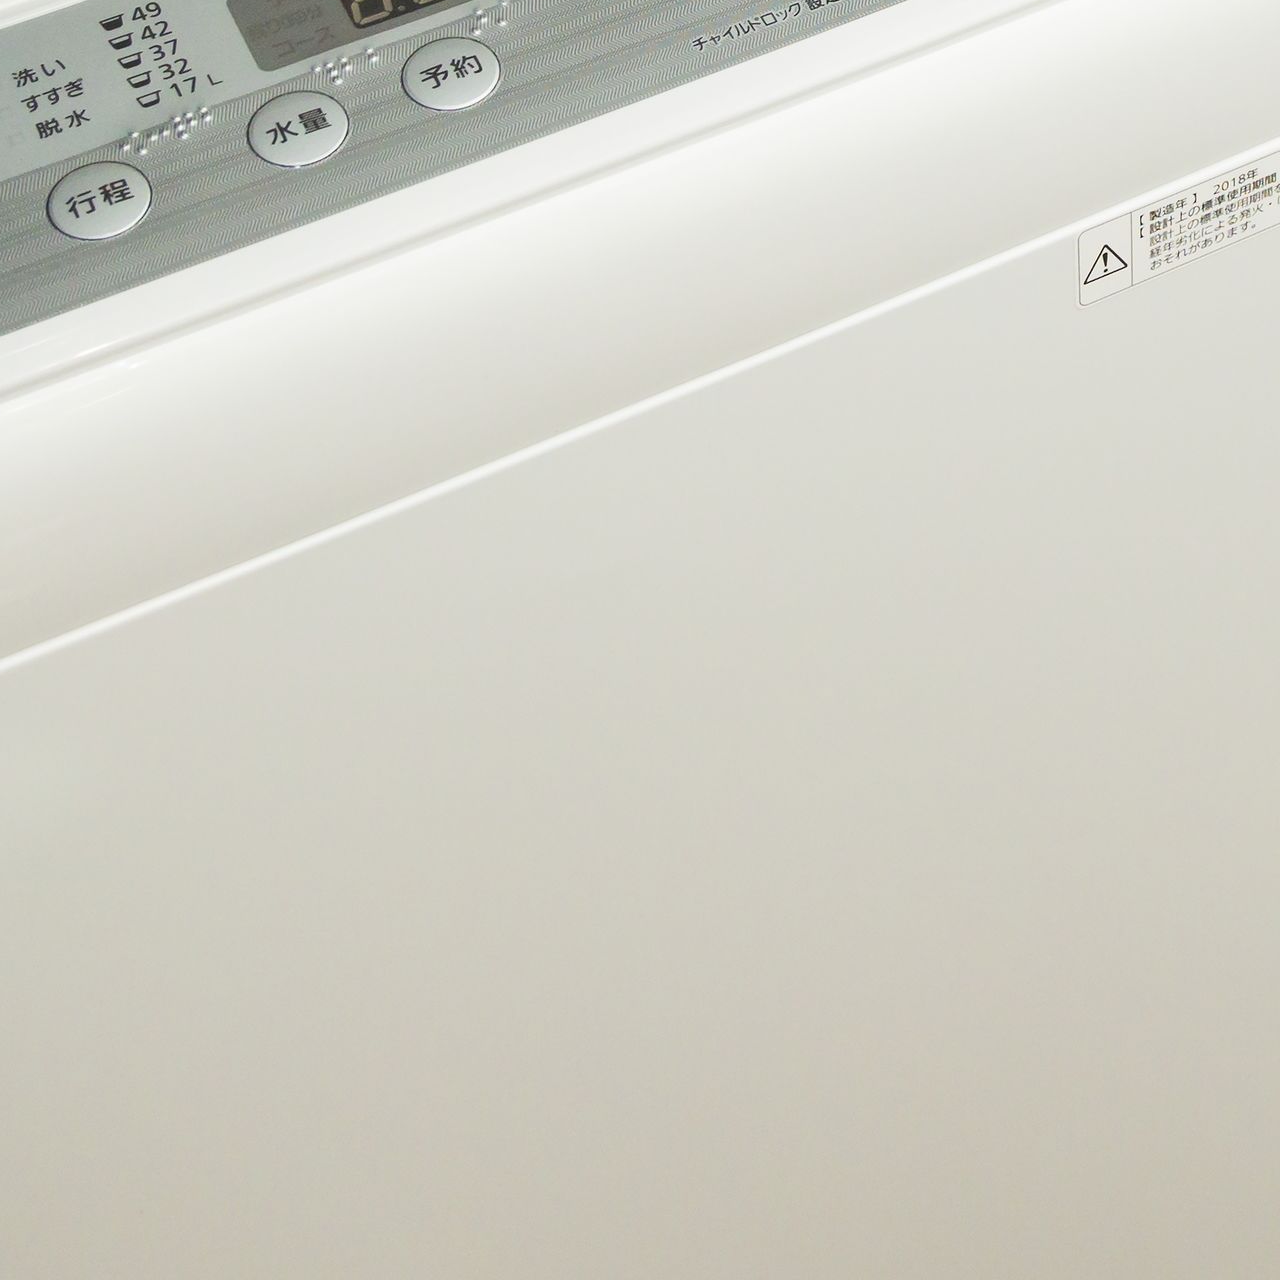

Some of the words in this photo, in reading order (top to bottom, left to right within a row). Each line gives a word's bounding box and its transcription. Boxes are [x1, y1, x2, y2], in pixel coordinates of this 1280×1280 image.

[131, 1, 162, 22] 49
[141, 20, 173, 41] 42
[692, 2, 802, 52] チャイルドロック
[149, 39, 178, 62] 37
[12, 59, 66, 88] 洗い
[158, 58, 192, 80] 32
[419, 54, 483, 89] 予約
[21, 78, 84, 113] すすぎ
[170, 76, 197, 98] 17
[206, 73, 223, 87] L
[35, 109, 91, 139] 脱水
[265, 107, 332, 145] 水量
[1213, 168, 1259, 195] 2018年
[65, 178, 135, 219] 行程
[1150, 220, 1257, 271] おそれがあります。
